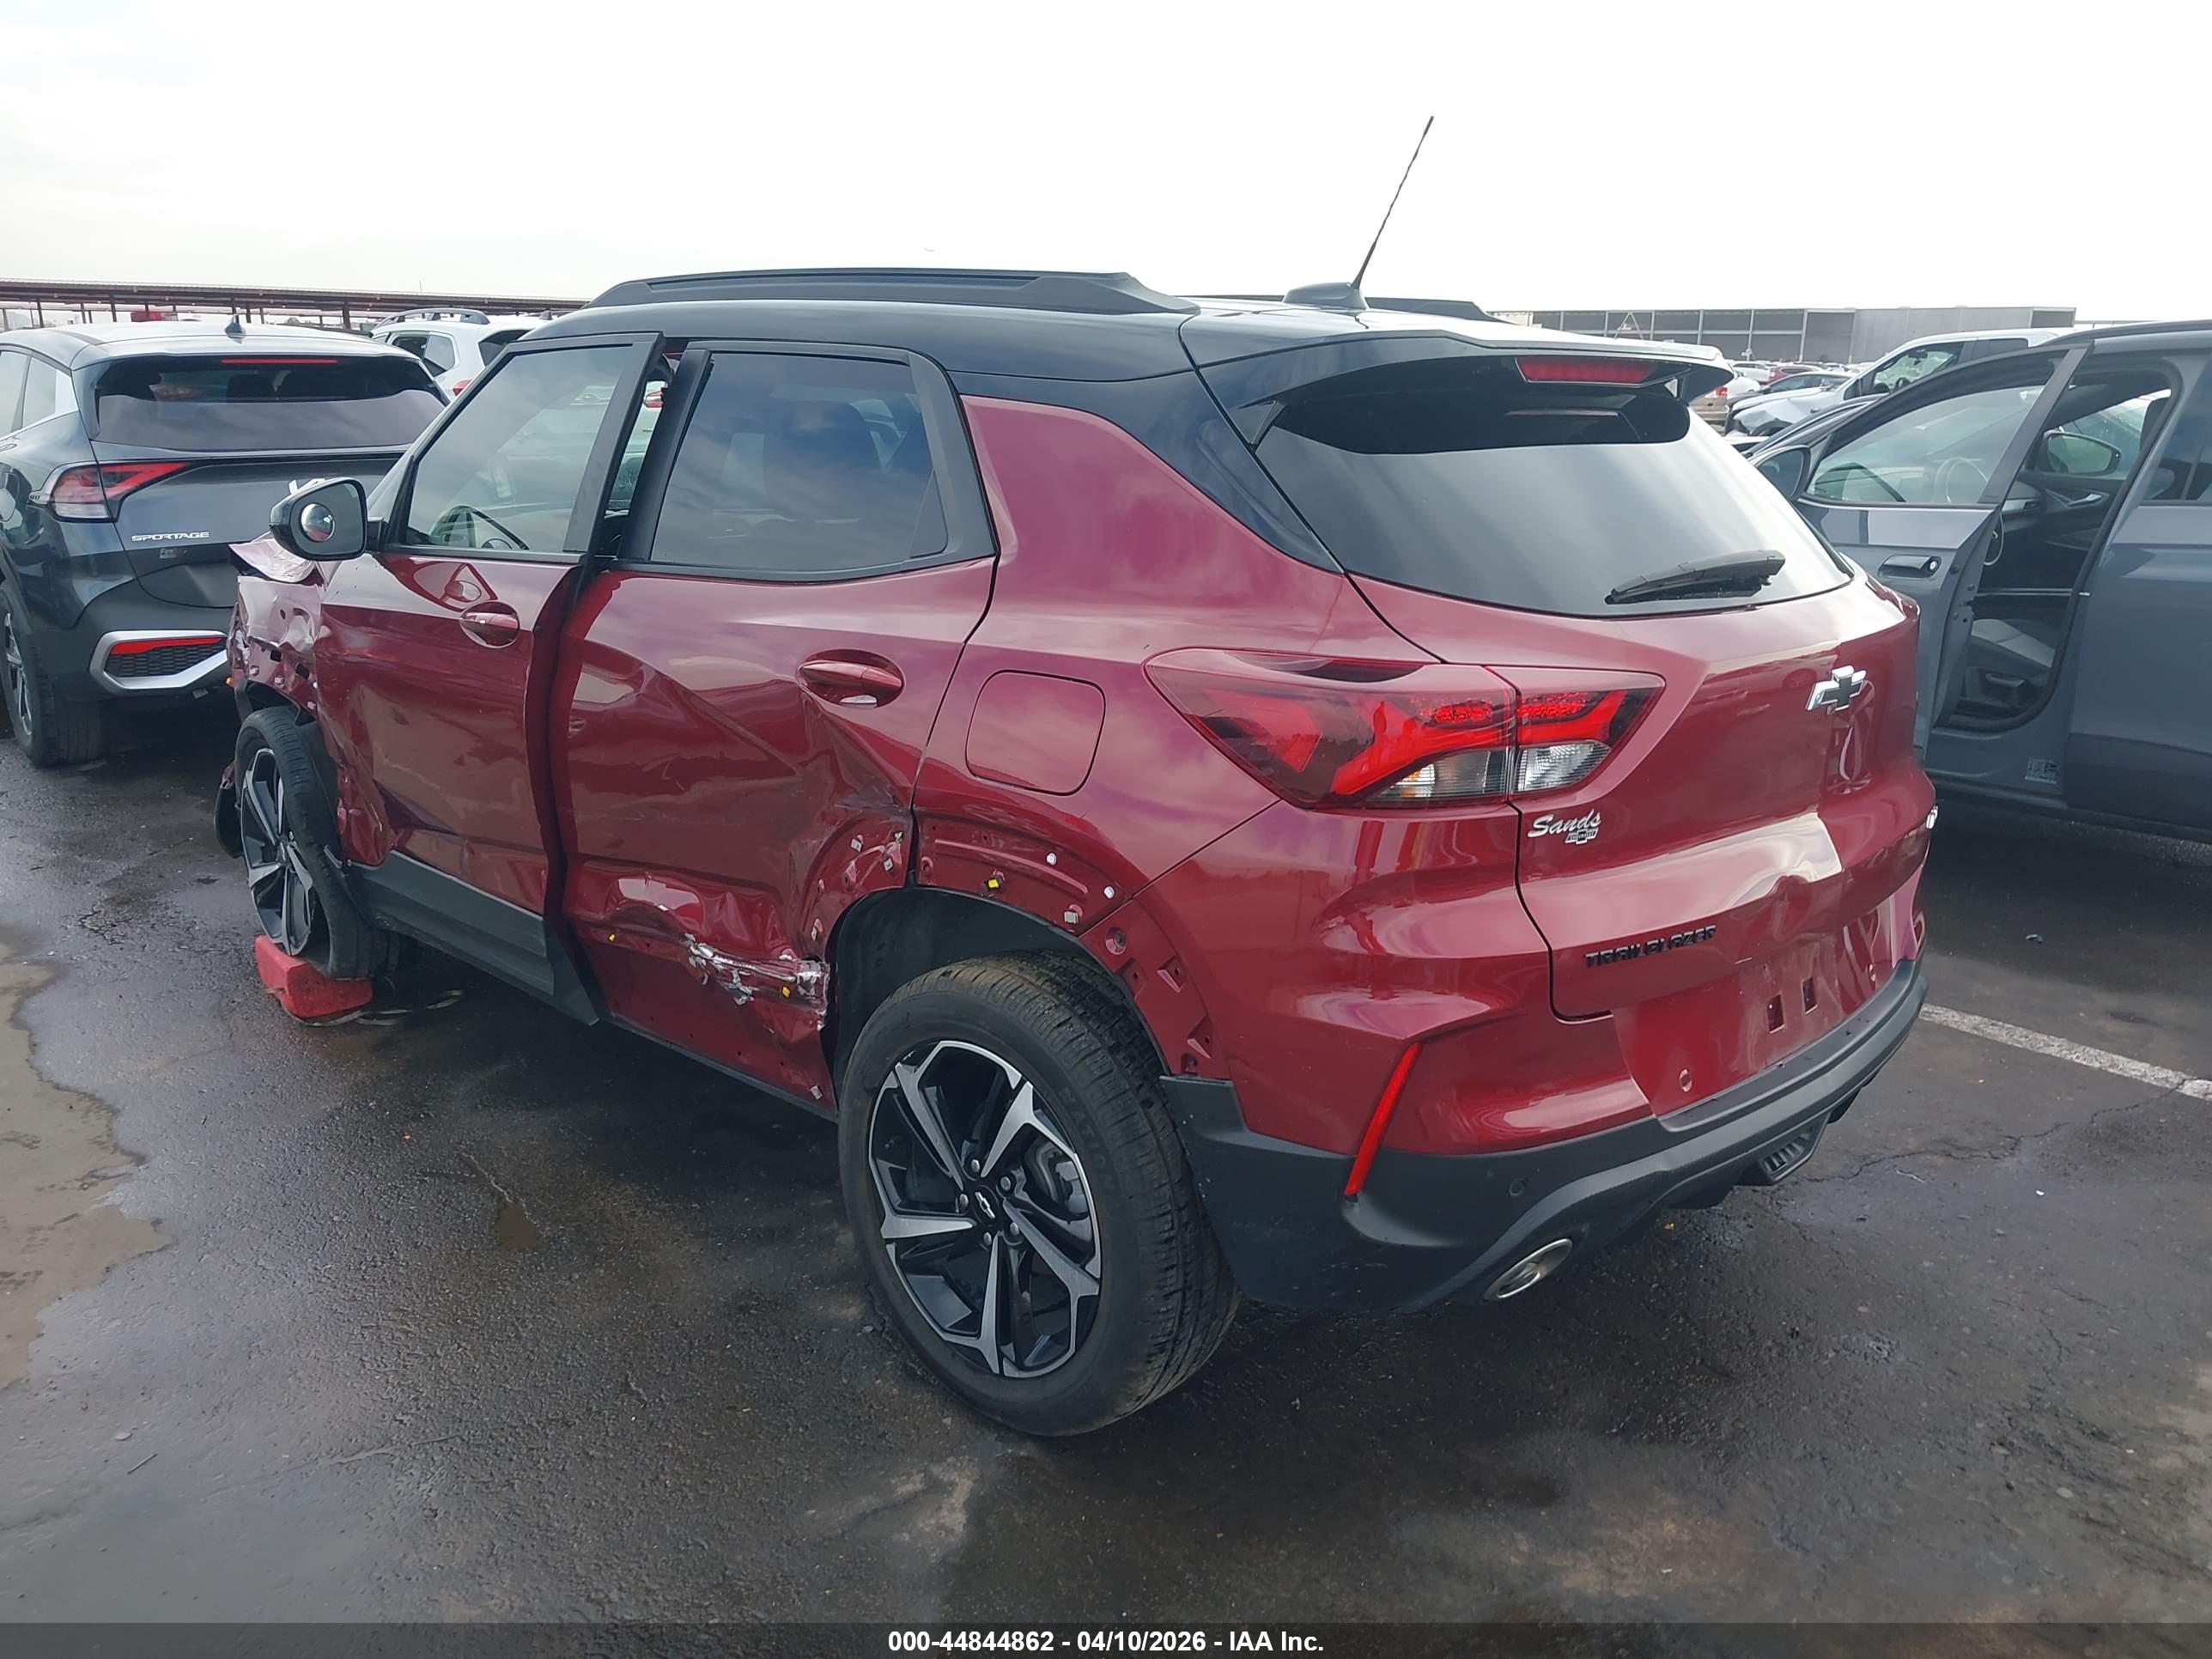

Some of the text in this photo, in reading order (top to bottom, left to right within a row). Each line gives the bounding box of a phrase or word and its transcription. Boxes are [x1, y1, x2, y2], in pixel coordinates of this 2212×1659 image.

[131, 532, 210, 542] SPORTAGE
[1528, 808, 1601, 838] Sands
[1584, 925, 1717, 967] TRAILBLAZER
